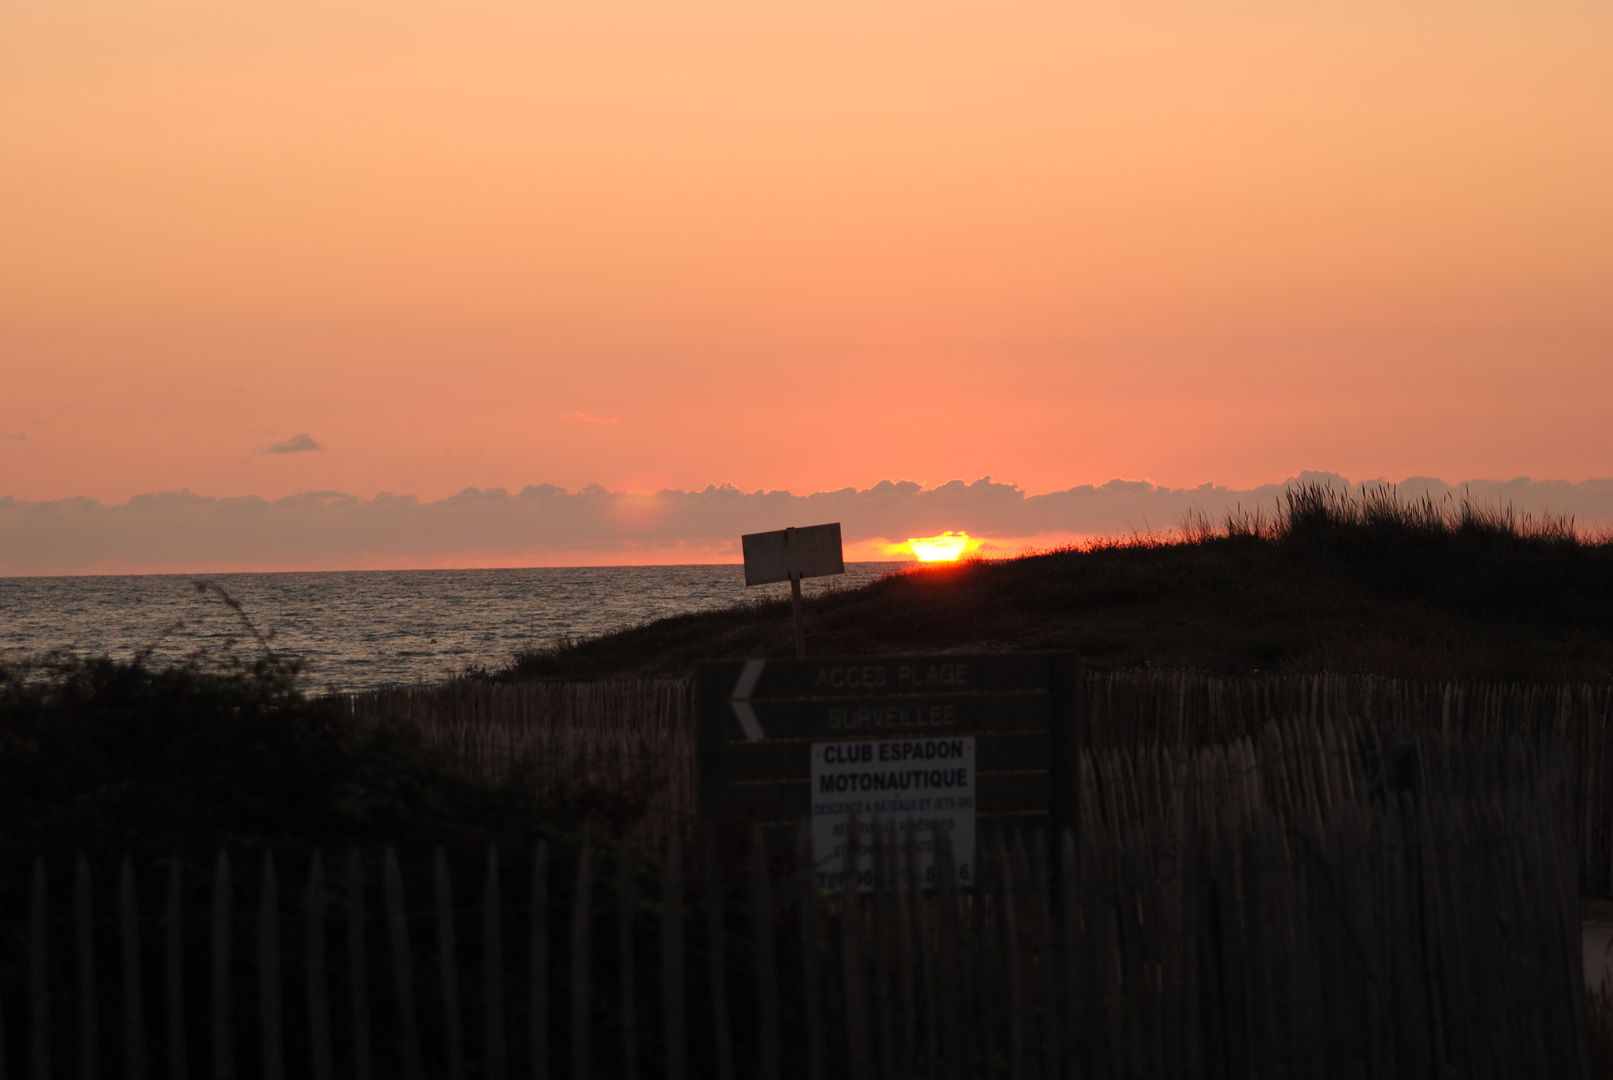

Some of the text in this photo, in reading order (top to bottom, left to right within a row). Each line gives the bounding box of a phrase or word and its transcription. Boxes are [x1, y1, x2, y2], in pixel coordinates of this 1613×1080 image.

[812, 663, 969, 689] ACCES PLAGE
[828, 704, 956, 730] SURVEILLEE
[824, 740, 963, 764] CLUB ESPADON
[820, 767, 968, 793] MOTONAUTIQUE
[813, 802, 863, 816] DESCENTE
[919, 798, 932, 811] ET
